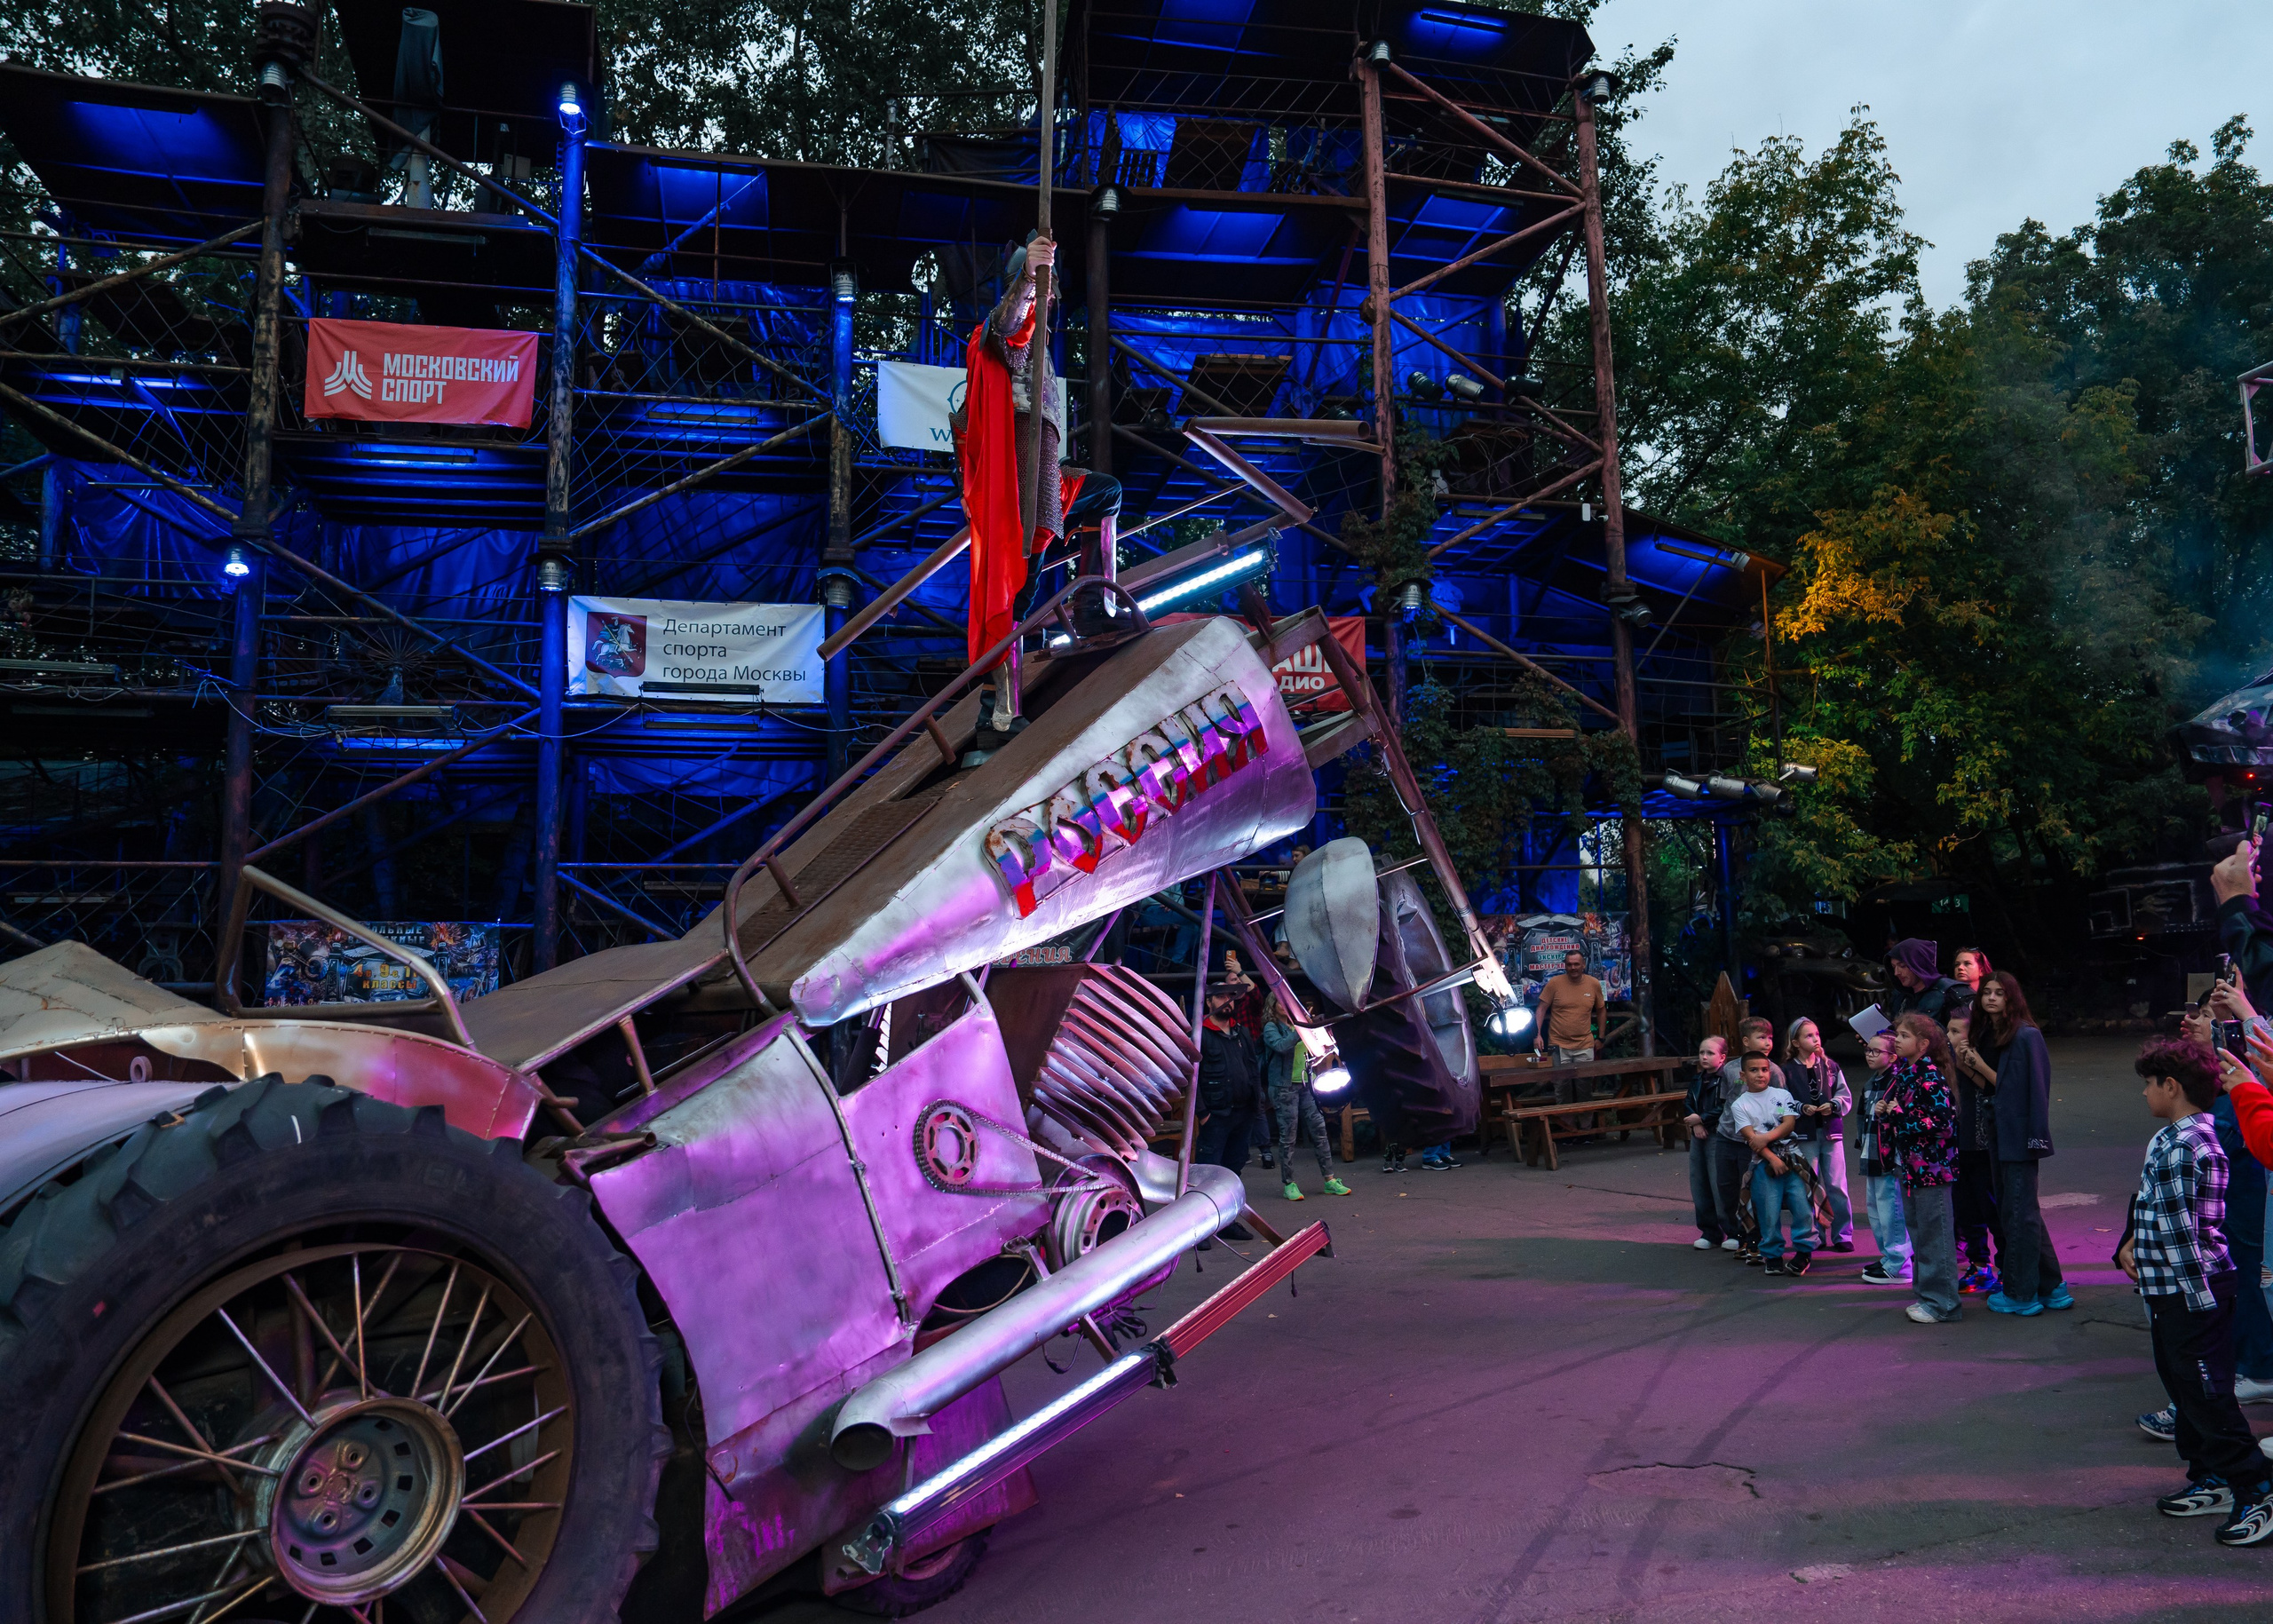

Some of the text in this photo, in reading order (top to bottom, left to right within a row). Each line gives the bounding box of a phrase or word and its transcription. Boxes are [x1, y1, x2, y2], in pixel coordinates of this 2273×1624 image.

[384, 353, 519, 383] МОСКОВСКИЙ
[382, 378, 447, 405] СПОРТ
[663, 619, 787, 638] Департамент
[663, 643, 727, 661] спорта
[663, 665, 806, 683] города Москвы
[982, 679, 1270, 920] РОССИЯ
[362, 979, 417, 989] классы
